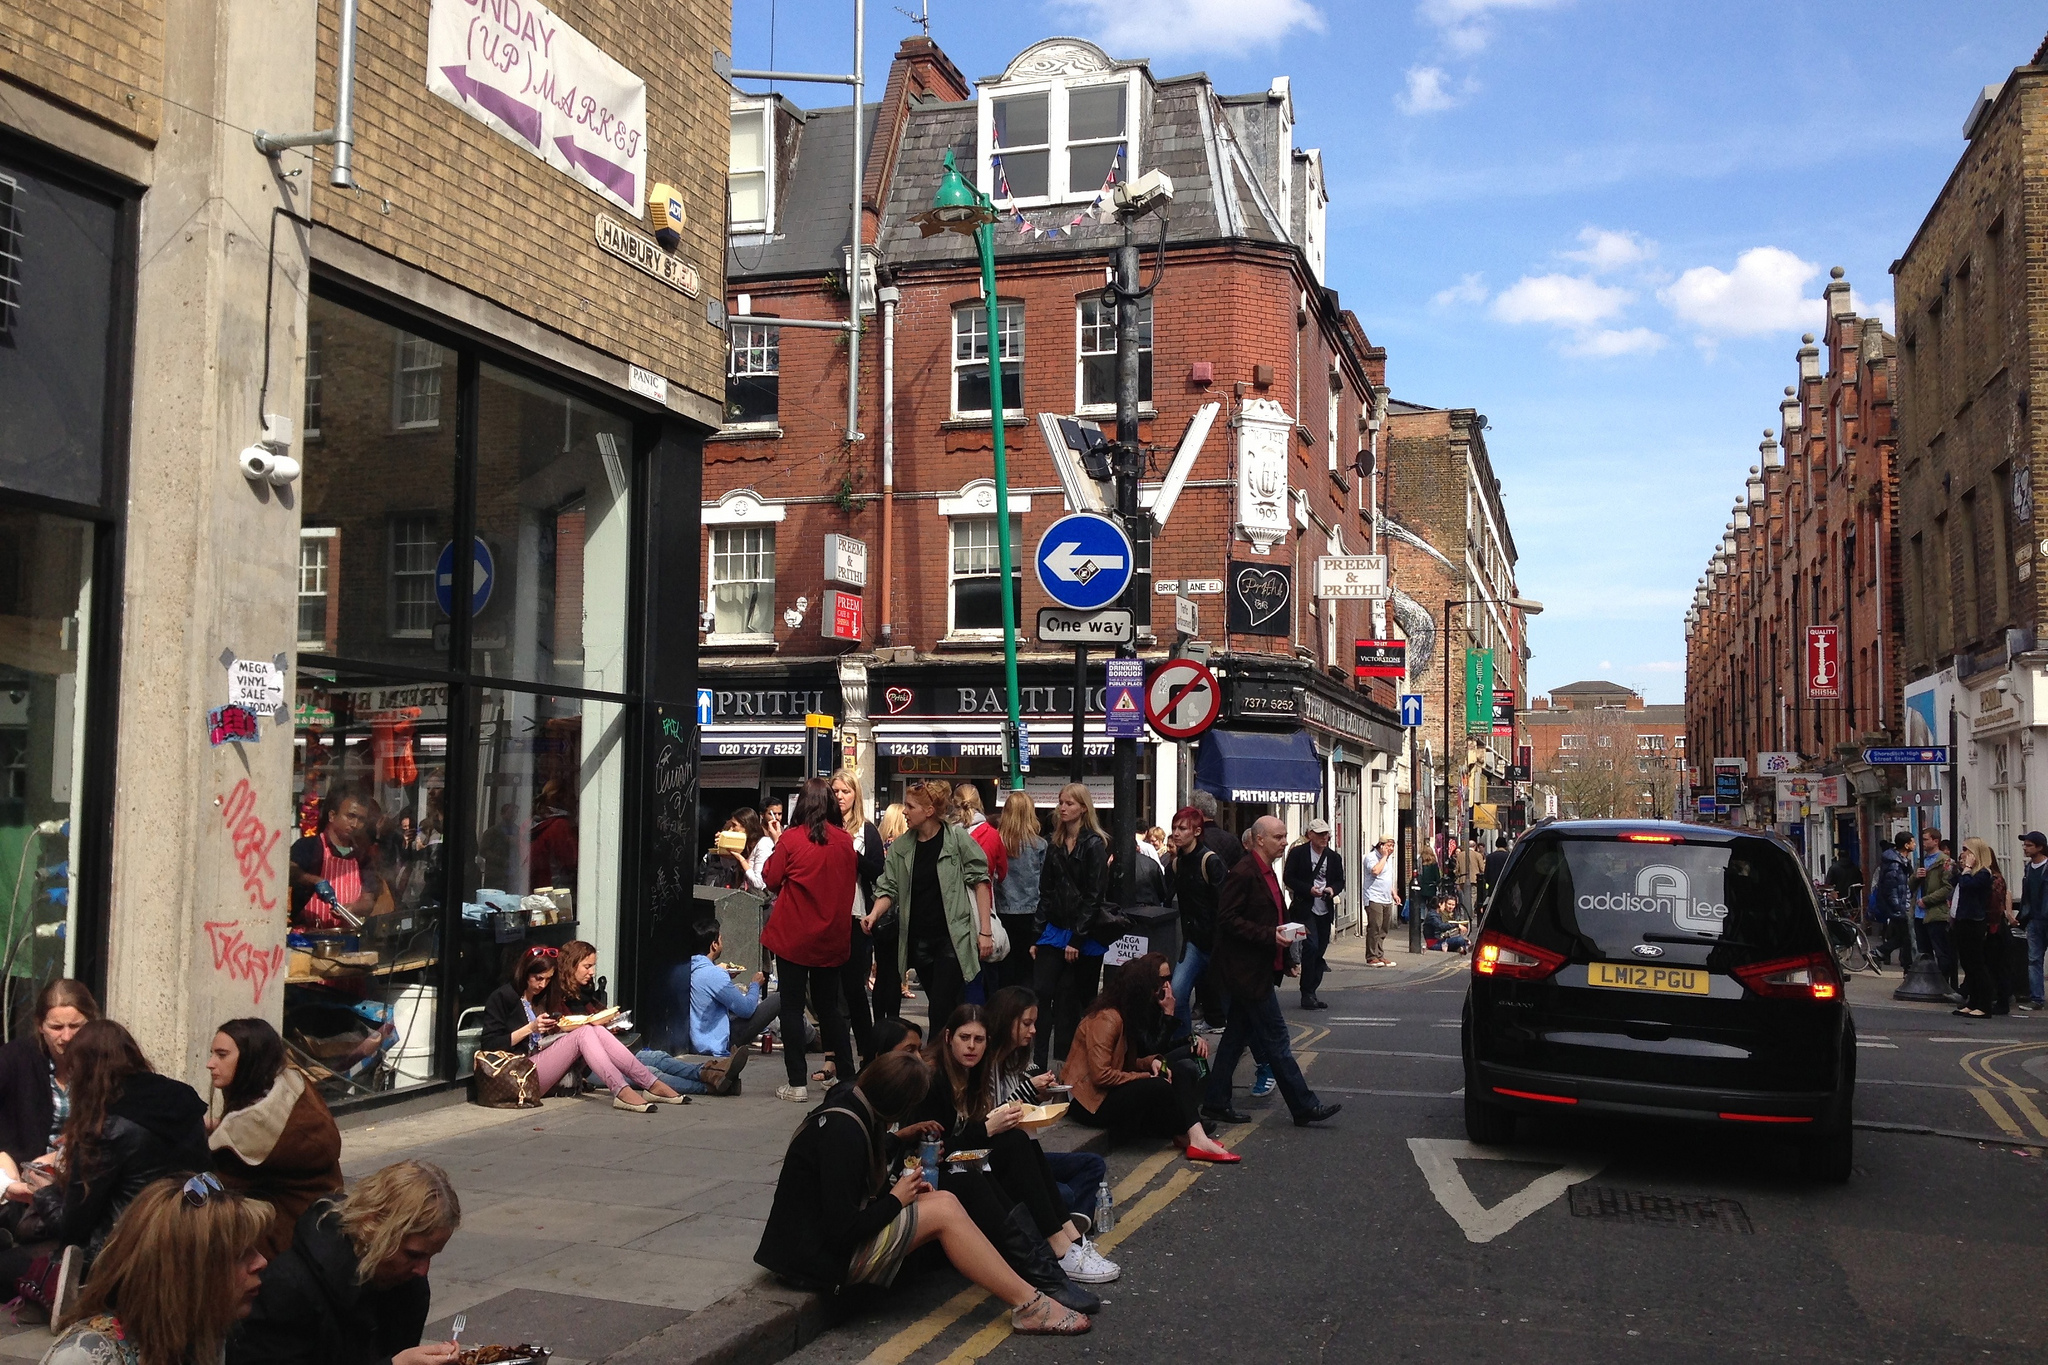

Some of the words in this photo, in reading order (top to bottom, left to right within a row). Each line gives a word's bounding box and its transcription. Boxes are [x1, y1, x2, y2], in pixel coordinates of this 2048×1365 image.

[464, 0, 556, 58] NDAY
[533, 69, 641, 158] MARKET
[669, 202, 681, 221] ADT
[603, 221, 661, 272] HANBURY
[633, 368, 659, 388] PANIC
[1256, 507, 1277, 521] 1903
[838, 539, 863, 557] PREEM
[847, 555, 853, 567] &
[1323, 559, 1381, 571] PREEM
[838, 566, 862, 583] PRITHI
[1346, 572, 1358, 583] &
[1187, 583, 1206, 591] ANE
[1323, 585, 1381, 596] PRITHI
[837, 596, 859, 611] PREEM
[1047, 617, 1081, 632] One
[1088, 622, 1124, 635] way
[239, 662, 267, 674] MEGA
[237, 676, 267, 687] VINYL
[240, 688, 265, 700] SALE
[957, 687, 1056, 713] BATI
[716, 691, 823, 715] PRITHI
[1244, 698, 1266, 708] 7377
[1270, 700, 1294, 711] 5252
[719, 744, 741, 755] 020
[743, 744, 769, 755] 7377
[774, 744, 802, 755] 5252
[890, 744, 929, 755] 124-126
[1084, 744, 1109, 755] 7377
[901, 756, 953, 772] OPEN
[1232, 789, 1315, 804] PRITHI&PREEM
[1578, 892, 1671, 914] addison
[1692, 898, 1729, 918] lee
[1115, 943, 1140, 951] VINYL
[1602, 966, 1647, 985] LM12
[1654, 970, 1695, 989] PGU
